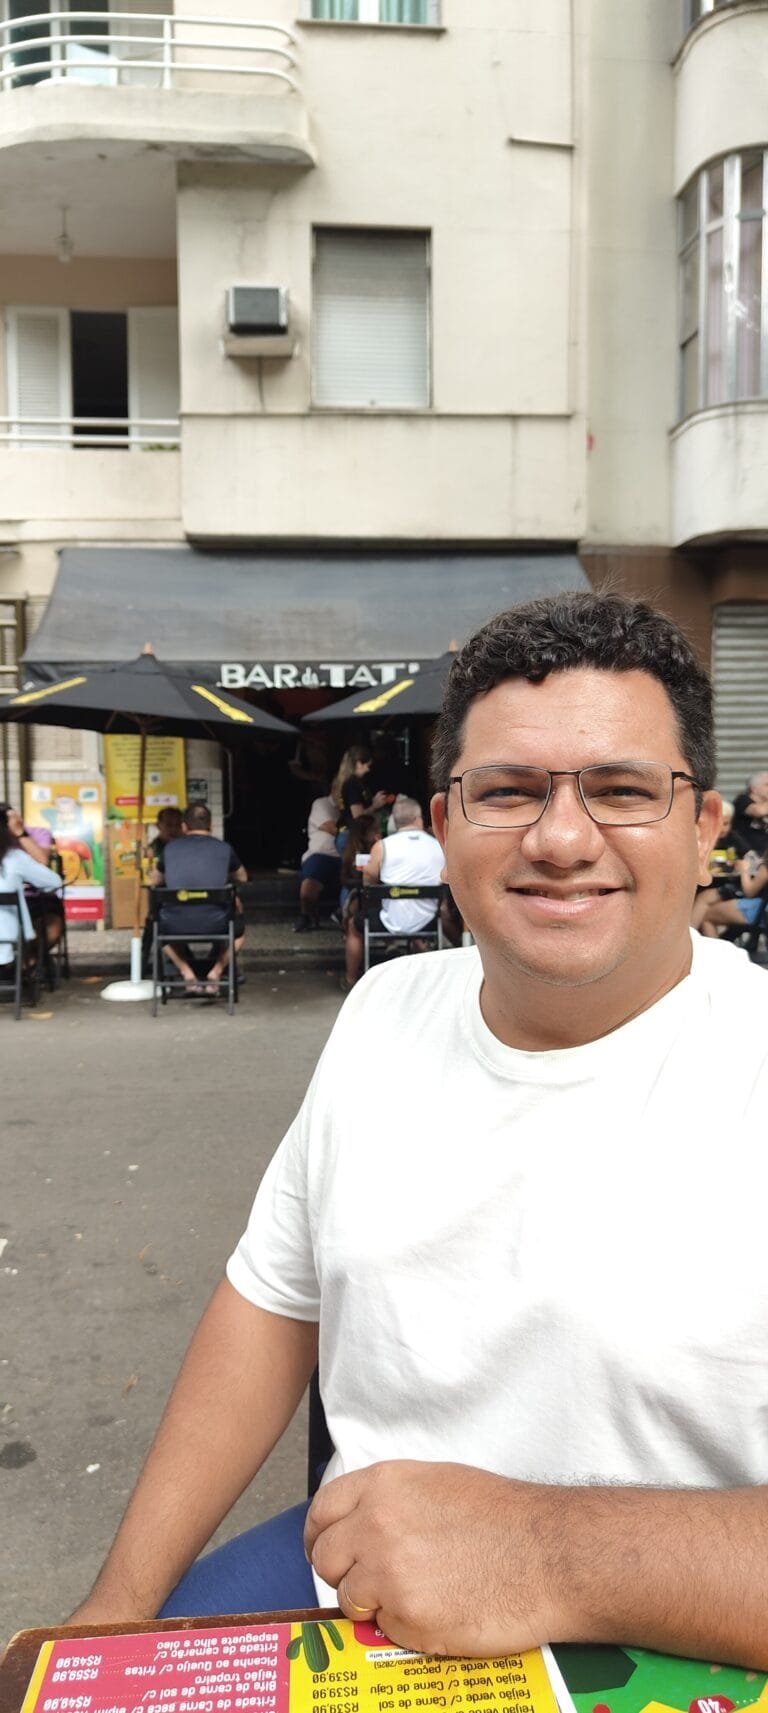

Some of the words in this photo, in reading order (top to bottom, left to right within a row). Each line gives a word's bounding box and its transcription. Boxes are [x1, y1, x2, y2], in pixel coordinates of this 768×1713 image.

[220, 663, 299, 688] BAR
[183, 1639, 190, 1648] e
[194, 1638, 217, 1648] alho
[221, 1632, 278, 1644] espaguete
[157, 1641, 180, 1651] óleo
[223, 1646, 236, 1655] de
[240, 1642, 278, 1654] Fritada
[153, 1650, 167, 1661] c/
[171, 1647, 219, 1658] camarão
[176, 1660, 212, 1672] Queijo
[216, 1660, 229, 1669] ao
[233, 1656, 278, 1668] Picanha
[461, 1662, 490, 1673] verde
[493, 1658, 523, 1669] Feijão
[125, 1665, 156, 1676] fritas
[159, 1664, 173, 1674] c/
[244, 1669, 277, 1680] feijão
[404, 1664, 441, 1676] paçoca
[446, 1665, 457, 1675] c/
[52, 1668, 98, 1682] R$59,90
[194, 1672, 240, 1684] tropeiro
[312, 1671, 357, 1683] R$39,90
[496, 1673, 526, 1684] Feijão
[236, 1683, 250, 1693] de
[254, 1680, 276, 1692] Bife
[413, 1681, 444, 1691] Carne
[448, 1679, 459, 1690] c/
[463, 1677, 494, 1688] Verde
[159, 1688, 177, 1700] sol
[181, 1686, 195, 1697] de
[199, 1684, 232, 1694] carne
[312, 1686, 358, 1700] R$39,90
[370, 1684, 393, 1695] Caju
[397, 1684, 410, 1694] de
[499, 1688, 530, 1700] Feijão
[142, 1690, 156, 1701] c/
[416, 1696, 446, 1706] Carne
[450, 1695, 462, 1706] c/
[466, 1693, 496, 1704] verde
[179, 1700, 213, 1712] Carne
[217, 1699, 231, 1709] de
[235, 1696, 276, 1708] Fritada
[312, 1702, 359, 1713] R$39,90
[379, 1701, 394, 1710] sol
[398, 1699, 411, 1709] de
[148, 1703, 175, 1713] seca
